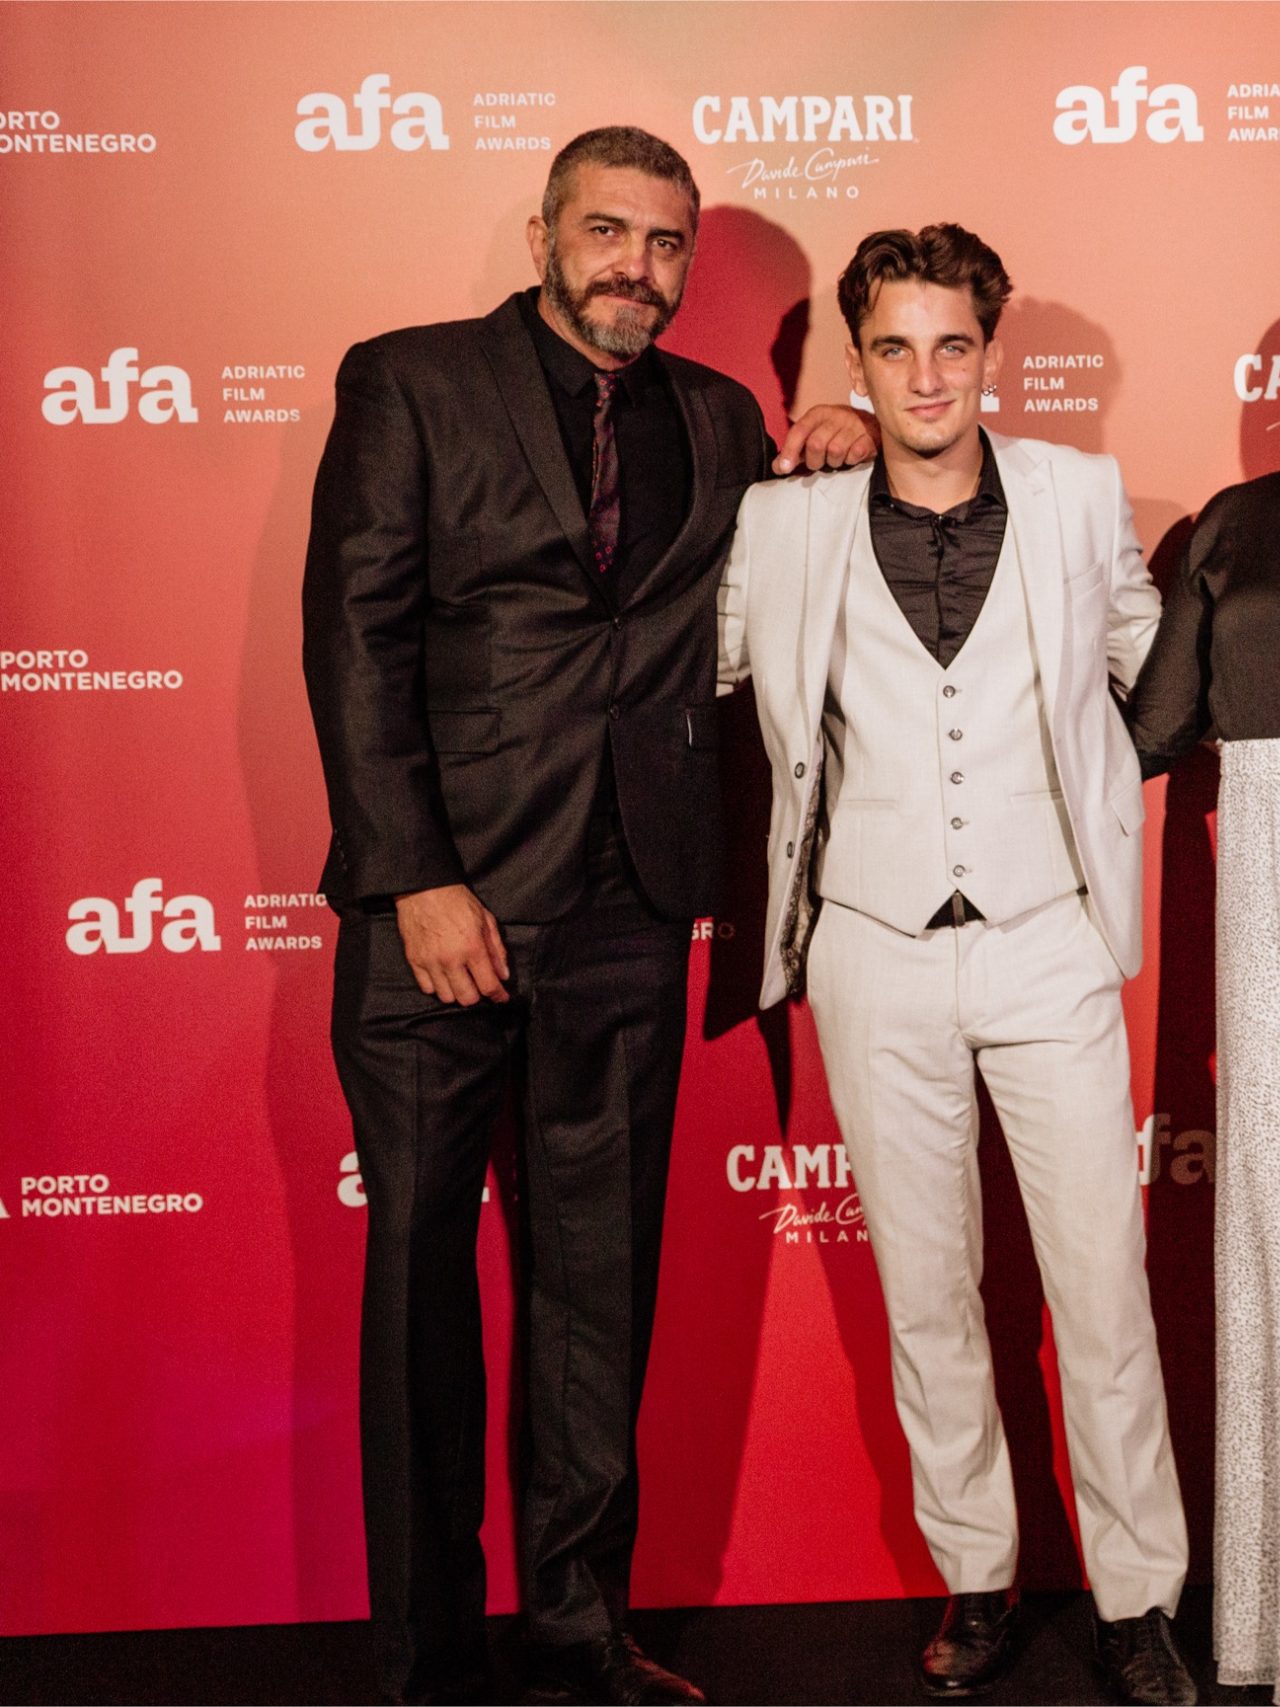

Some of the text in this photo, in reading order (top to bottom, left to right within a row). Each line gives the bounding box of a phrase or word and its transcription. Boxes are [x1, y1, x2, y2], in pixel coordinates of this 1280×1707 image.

[473, 93, 556, 106] ADRIATIC
[1053, 65, 1204, 145] afa
[294, 73, 449, 152] afa
[692, 95, 913, 144] CAMPARI
[1228, 106, 1269, 120] FILM
[0, 111, 60, 130] RTO
[475, 115, 516, 129] FILM
[0, 133, 157, 153] ONTENEGRO
[475, 137, 551, 151] AWARDS
[727, 147, 879, 189] Davide Campari
[754, 186, 859, 199] MILANO
[1022, 355, 1104, 369] ADRIATIC
[221, 365, 305, 379] ADRIATIC
[41, 347, 199, 426] afa
[1024, 377, 1065, 391] FILM
[223, 388, 265, 401] FILM
[1024, 397, 1098, 412] AWARDS
[223, 409, 301, 423] AWARDS
[0, 650, 89, 669] PORTO
[0, 670, 183, 692] MONTENEGRO
[244, 894, 328, 908] ADRIATIC
[65, 877, 221, 955] afa
[245, 916, 287, 929] FILM
[245, 936, 322, 950] AWARDS
[21, 1174, 109, 1195] PORTO
[22, 1193, 204, 1217] MONTENEGRO
[758, 1202, 834, 1234] Davide
[785, 1230, 869, 1244] MILAN
